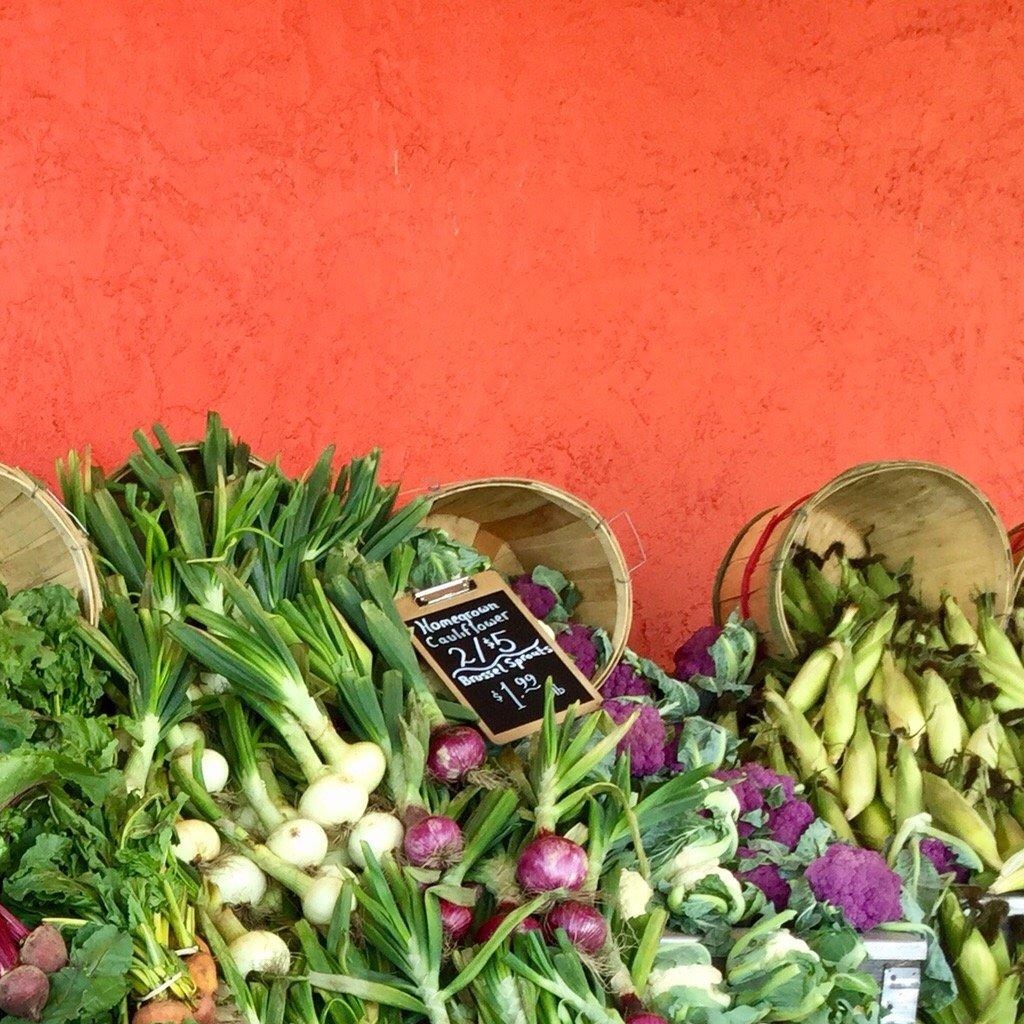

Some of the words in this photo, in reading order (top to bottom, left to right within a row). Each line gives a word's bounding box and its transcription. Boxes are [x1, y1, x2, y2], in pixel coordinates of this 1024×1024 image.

[414, 602, 500, 635] Homegrown
[425, 610, 510, 648] Cauliflower
[457, 662, 508, 687] Brussel
[503, 645, 554, 670] Sprouts
